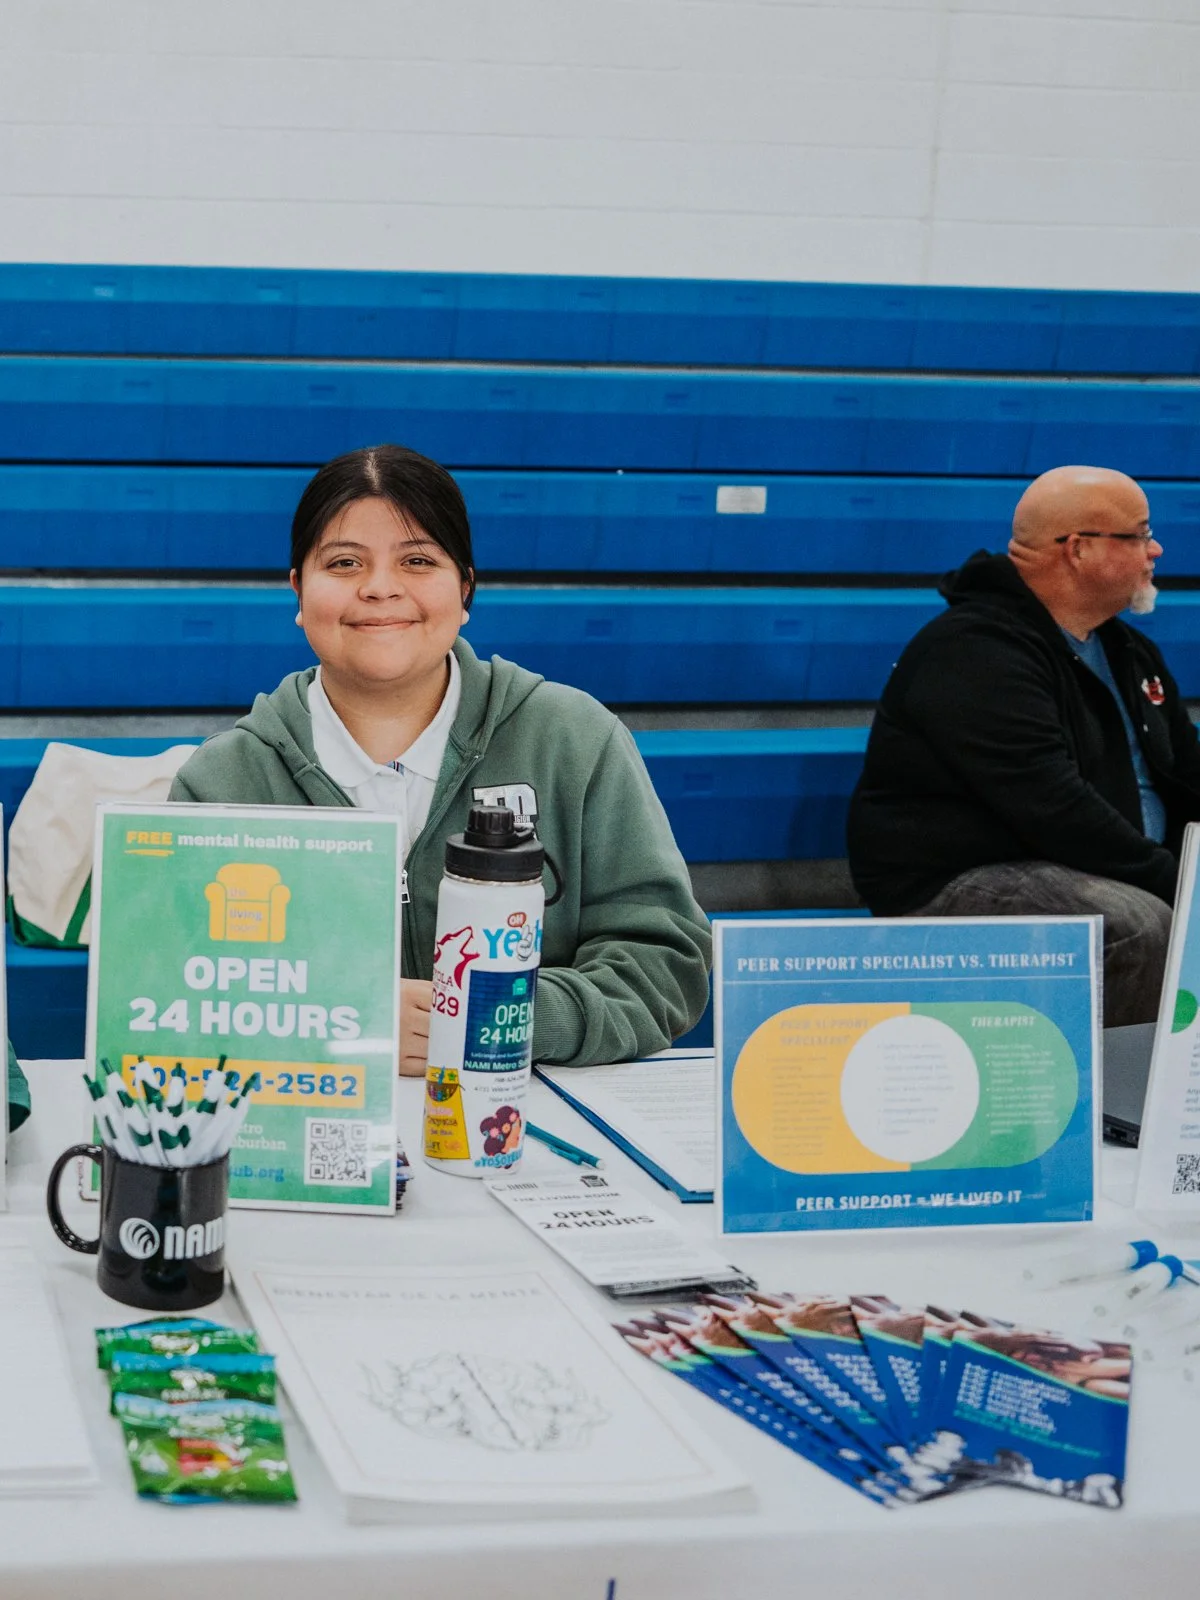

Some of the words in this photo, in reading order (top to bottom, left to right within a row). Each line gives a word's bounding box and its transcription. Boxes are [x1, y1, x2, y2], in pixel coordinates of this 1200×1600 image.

[126, 831, 173, 845] FREE
[177, 833, 240, 848] mental
[243, 834, 300, 849] health
[305, 837, 374, 854] support
[229, 908, 262, 922] living
[736, 957, 780, 972] PEER
[784, 956, 858, 972] SUPPORT
[862, 955, 955, 970] SPECIALIST
[959, 955, 985, 969] VS.
[988, 953, 1077, 968] THERAPIST
[183, 955, 309, 994] OPEN
[432, 987, 459, 1017] 029
[128, 997, 190, 1034] 24
[200, 1000, 362, 1040] HOURS
[971, 1015, 1036, 1028] THERAPIST
[479, 1026, 502, 1045] 24
[464, 1060, 491, 1070] NAMI
[492, 1060, 517, 1071] Metro
[236, 1124, 263, 1135] etro
[231, 1165, 285, 1183] ub.org
[585, 1191, 621, 1200] ROOM
[796, 1197, 835, 1211] PEER
[839, 1194, 912, 1209] SUPPORT
[930, 1192, 954, 1206] WE
[959, 1190, 1004, 1206] LIVED
[1007, 1190, 1022, 1203] IT
[540, 1221, 571, 1230] 24
[576, 1214, 655, 1229] HOURS
[553, 1208, 616, 1219] OPEN
[163, 1216, 225, 1260] NAM
